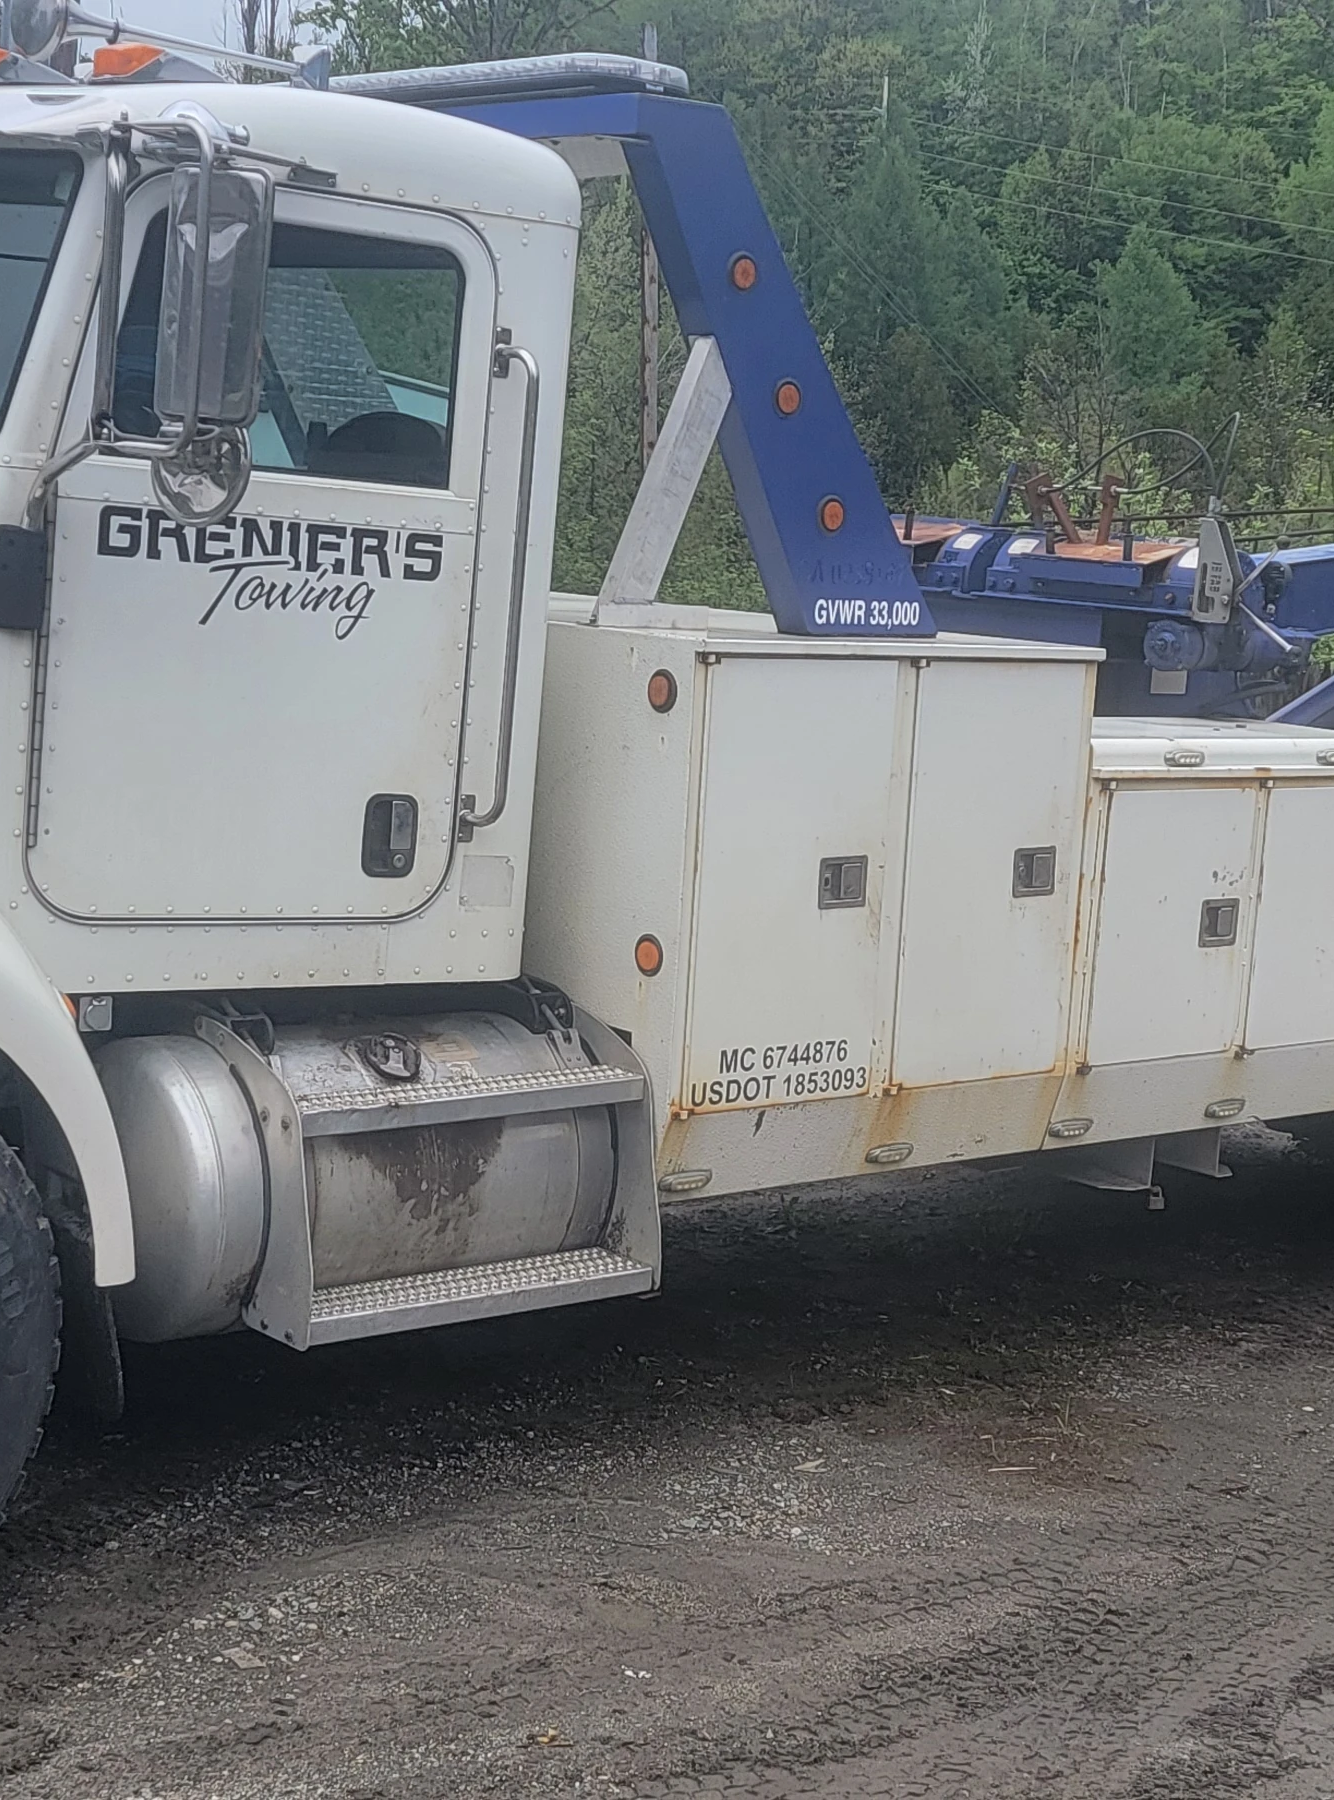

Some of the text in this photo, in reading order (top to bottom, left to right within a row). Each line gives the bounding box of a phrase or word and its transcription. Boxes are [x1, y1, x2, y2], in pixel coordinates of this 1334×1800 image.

[97, 505, 444, 582] GRENIER'S
[198, 559, 376, 641] Towing
[814, 598, 920, 631] GVWR 33,000
[719, 1039, 848, 1075] MC 6744876
[691, 1066, 867, 1107] USDOT 1853093
